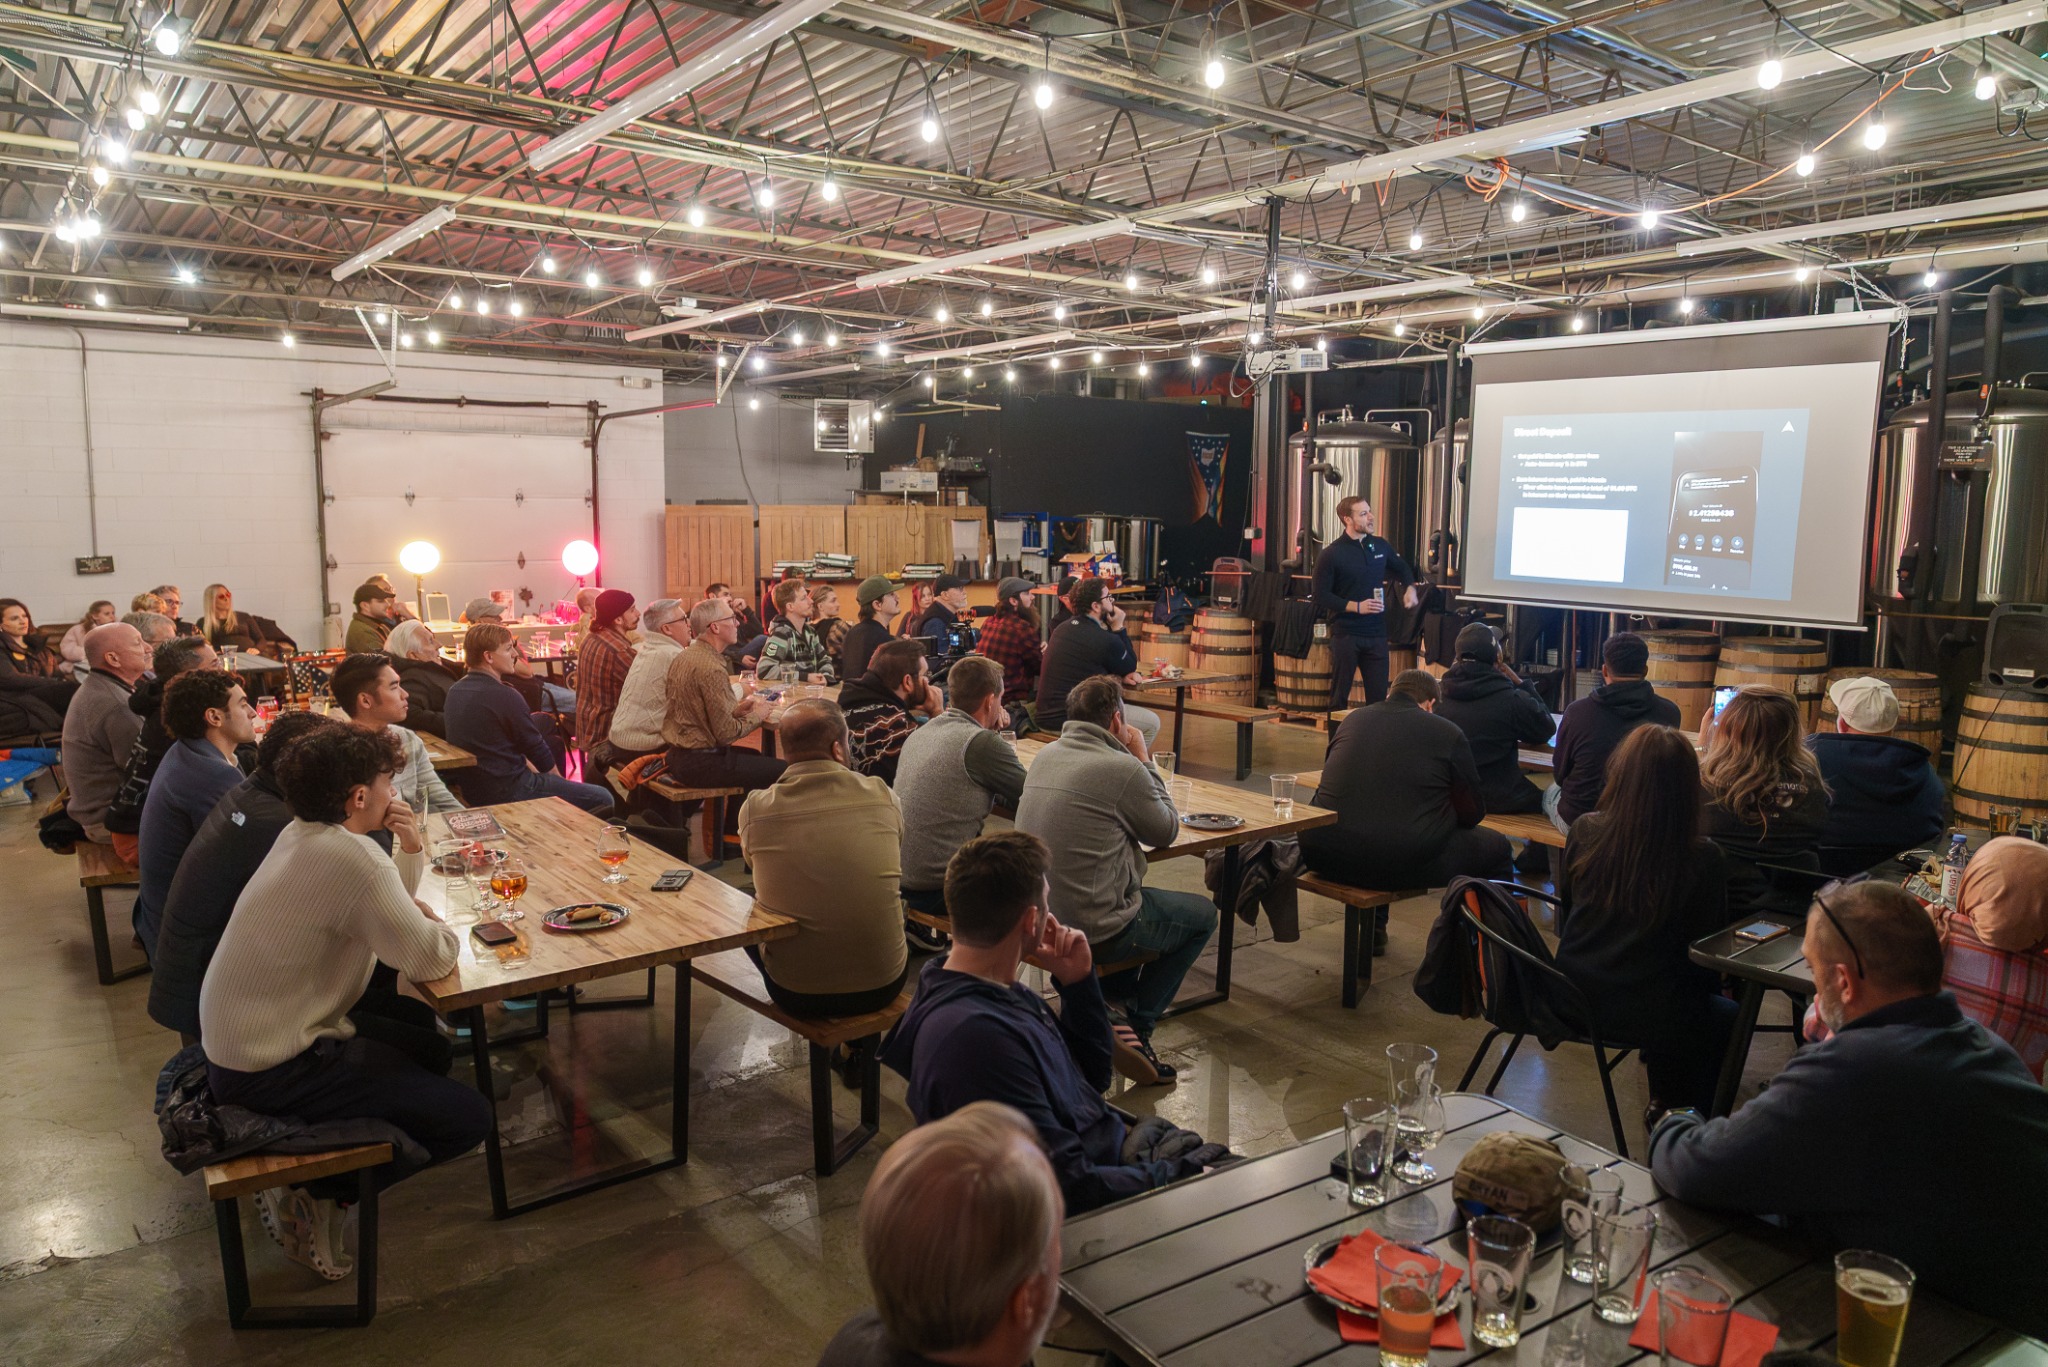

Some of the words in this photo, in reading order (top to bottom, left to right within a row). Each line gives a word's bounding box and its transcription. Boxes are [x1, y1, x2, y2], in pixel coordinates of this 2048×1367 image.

[1514, 427, 1539, 437] Direct
[1539, 426, 1572, 438] Deposit
[1948, 874, 1957, 897] evian
